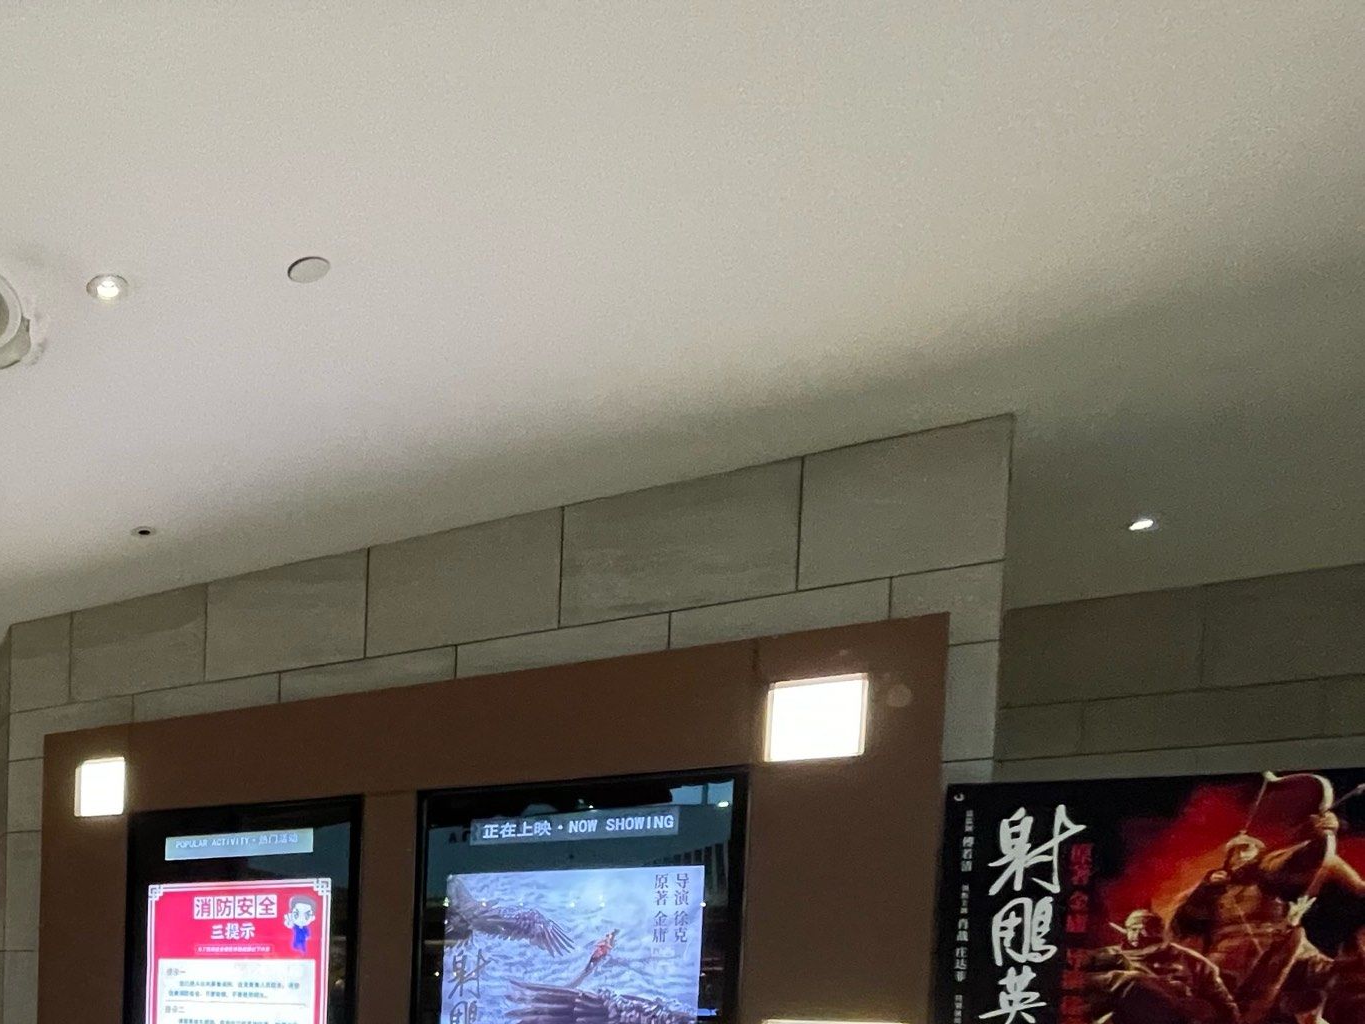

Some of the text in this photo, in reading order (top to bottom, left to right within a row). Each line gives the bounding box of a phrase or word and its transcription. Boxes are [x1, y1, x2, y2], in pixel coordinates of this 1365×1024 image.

[482, 815, 674, 839] 正在上映 NOW SHOWING
[175, 833, 298, 848] POPULAR ACTIVITY 热门活动
[194, 895, 277, 919] 消防安全
[652, 873, 669, 943] 原著 金庸
[674, 873, 689, 943] 导演 徐克
[211, 922, 255, 940] 三提示
